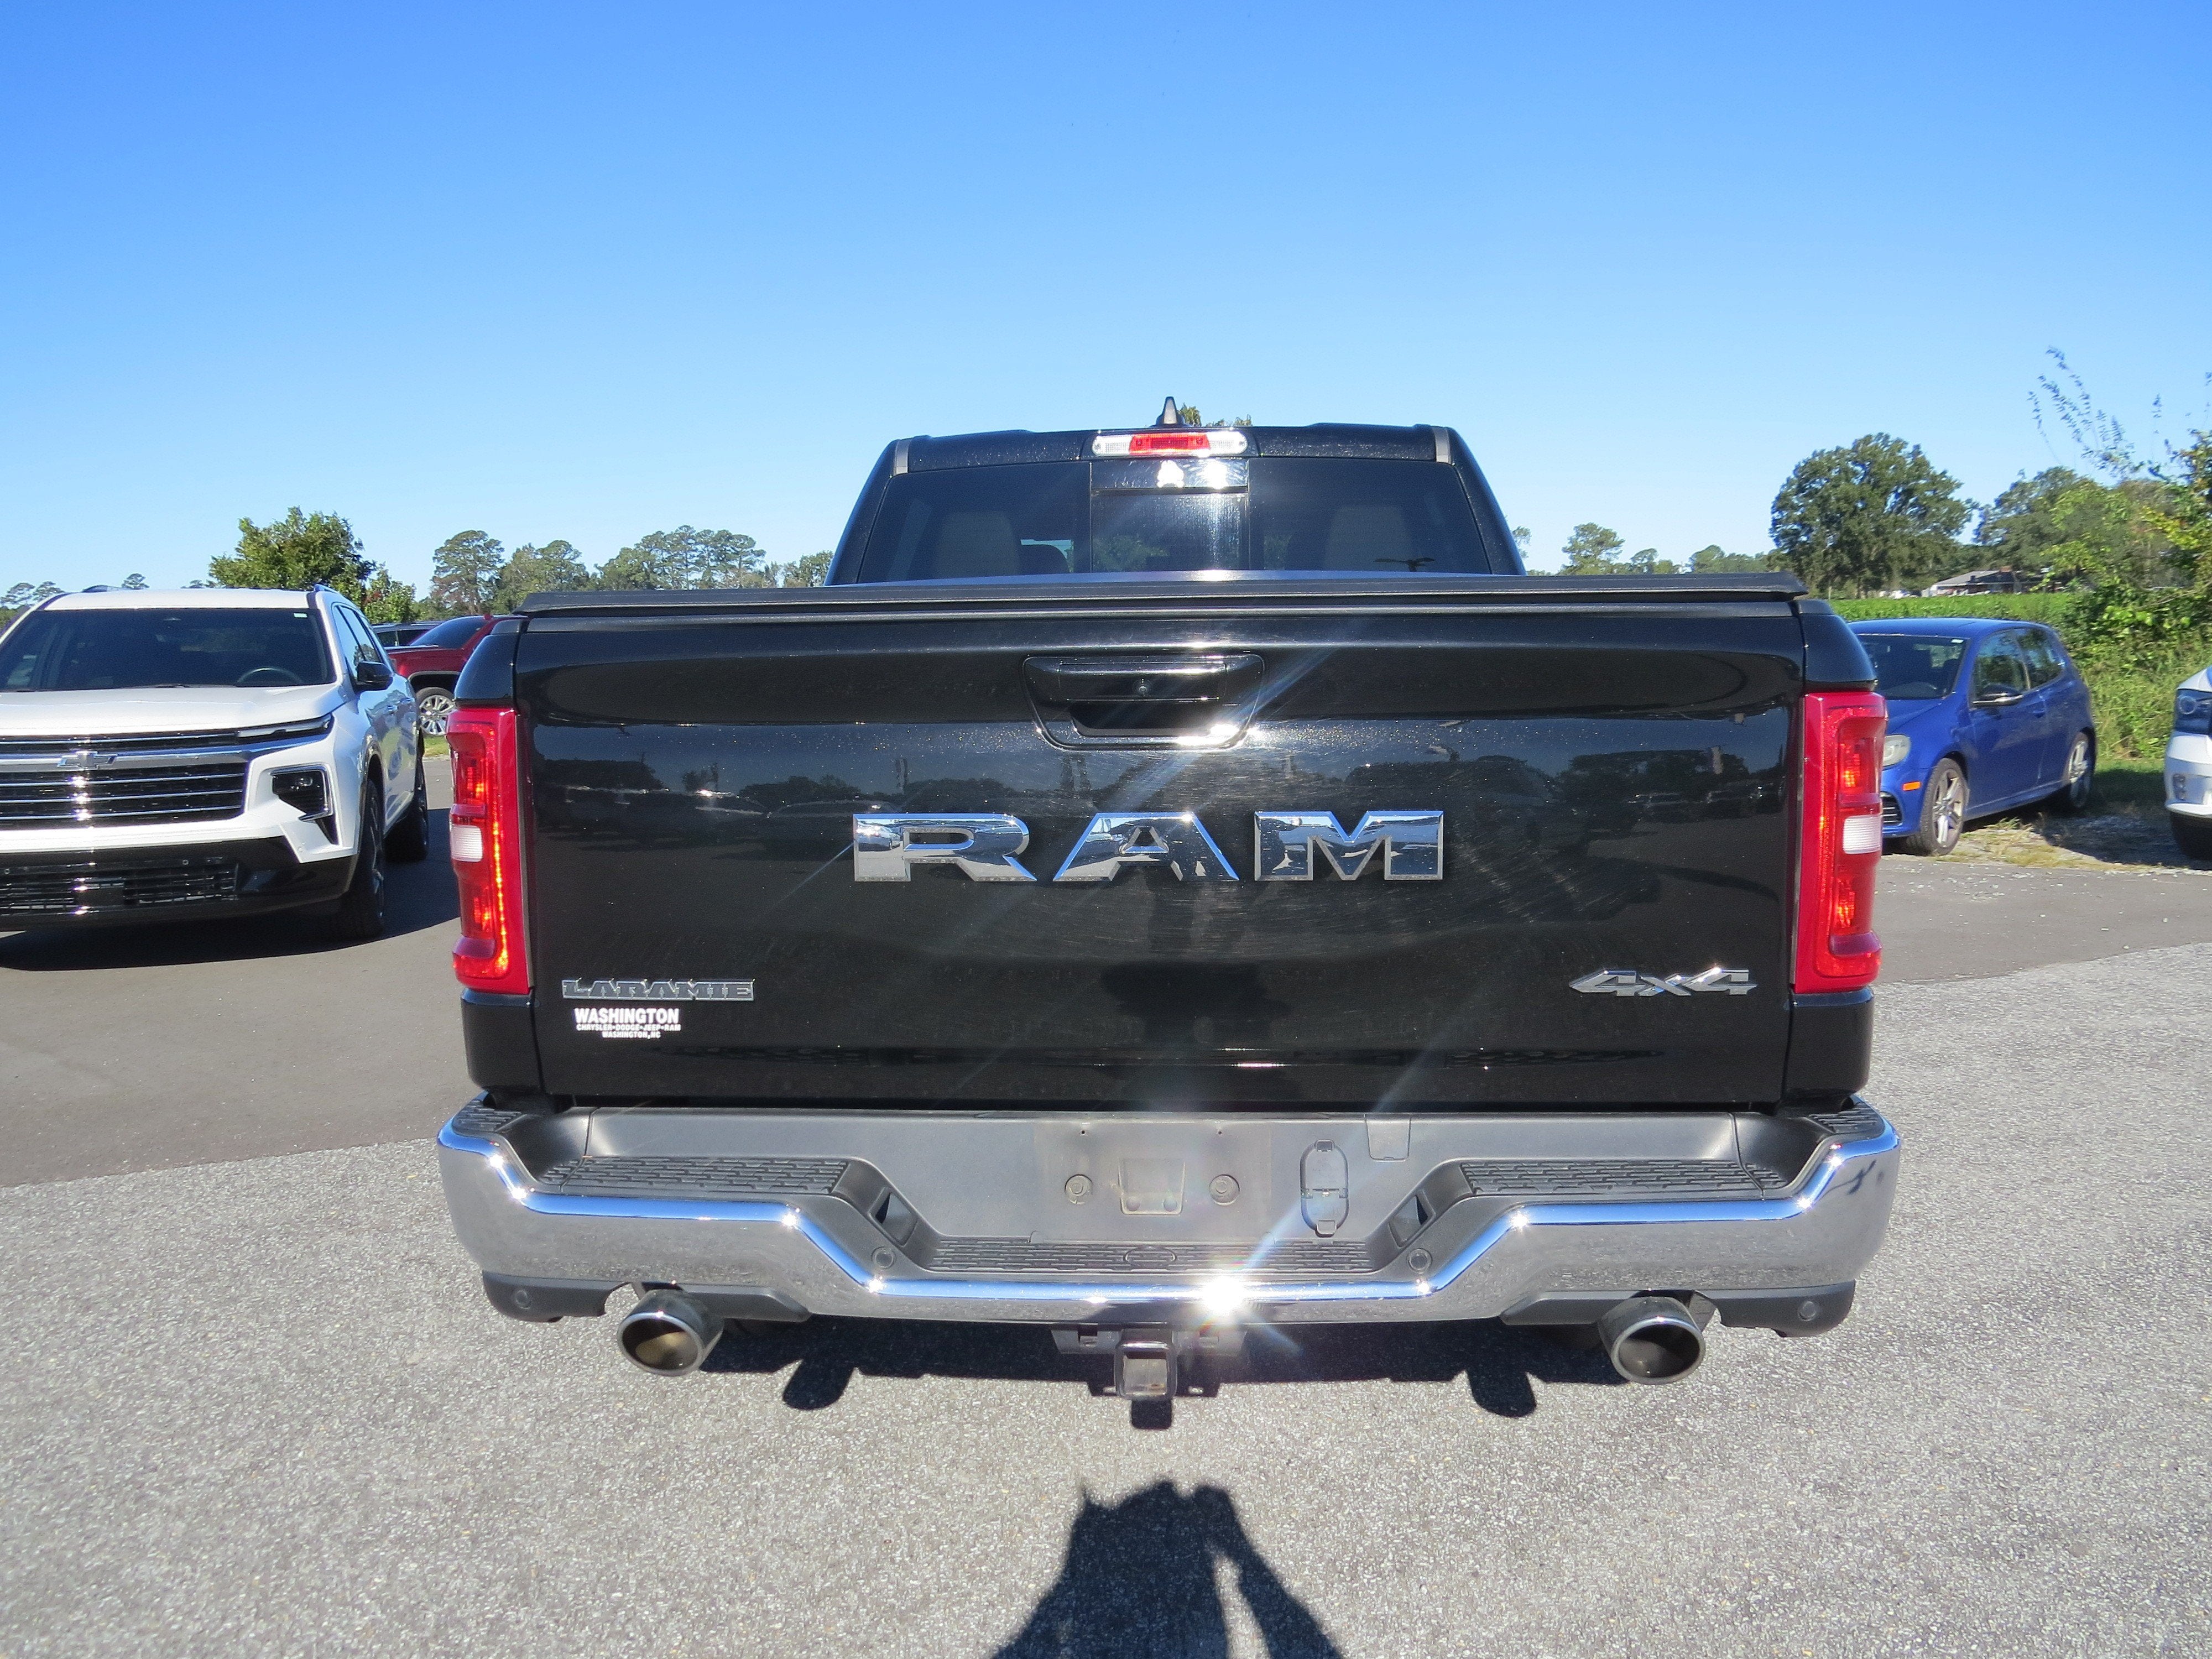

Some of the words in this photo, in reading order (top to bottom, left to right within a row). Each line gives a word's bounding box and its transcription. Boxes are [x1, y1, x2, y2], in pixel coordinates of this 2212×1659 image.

[852, 811, 1444, 883] RAM
[561, 978, 756, 1001] LARAMIE
[574, 1008, 680, 1024] WASHINGTON
